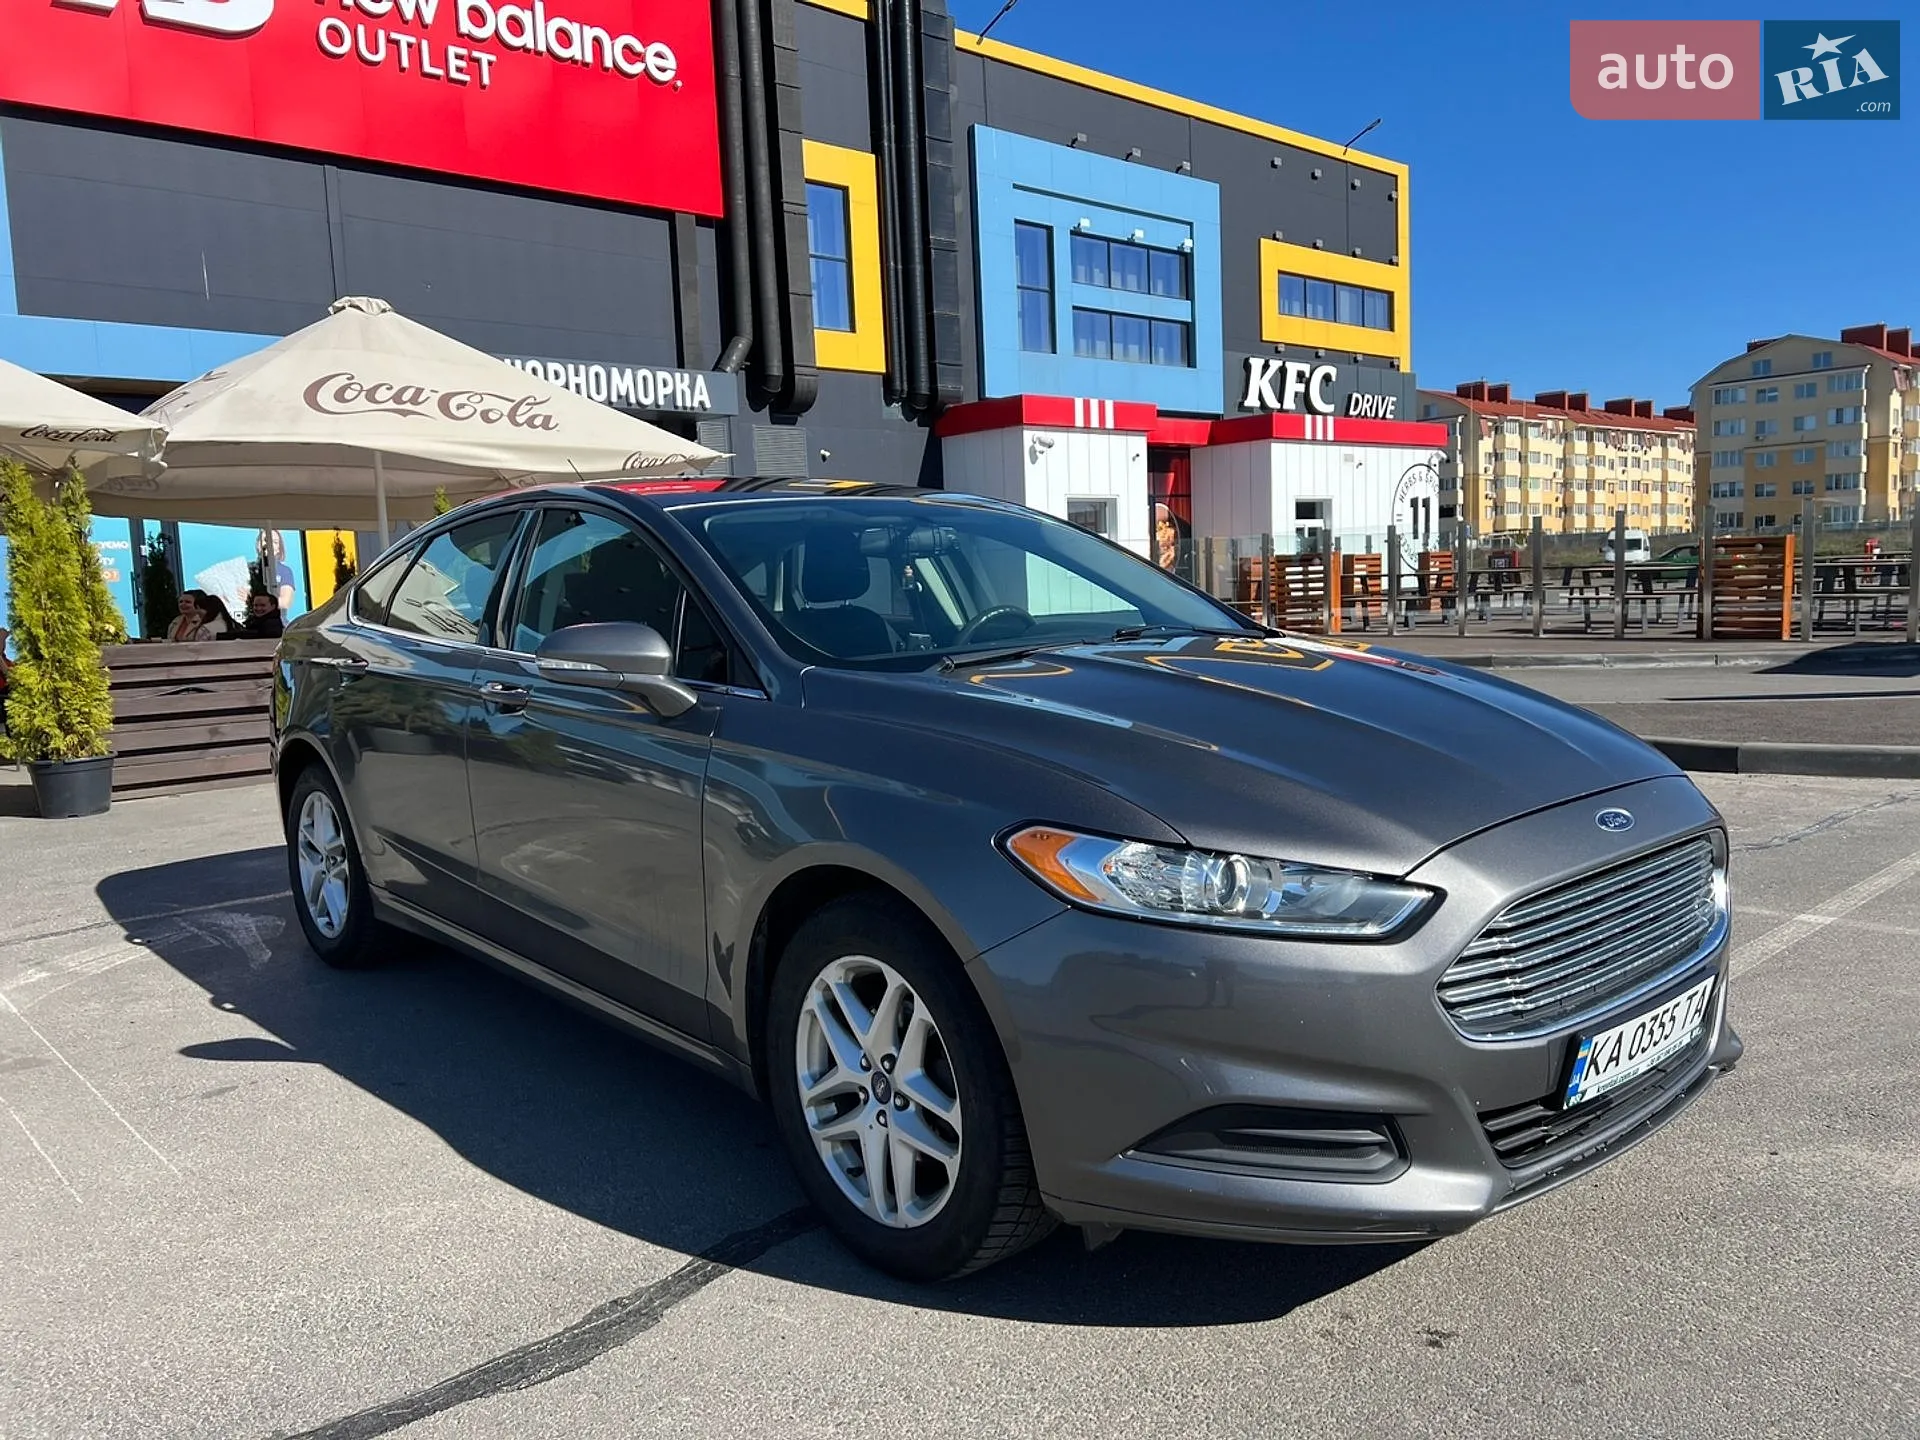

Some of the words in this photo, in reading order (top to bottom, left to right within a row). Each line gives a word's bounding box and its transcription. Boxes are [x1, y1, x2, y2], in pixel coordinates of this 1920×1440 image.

[317, 17, 497, 89] OUTLET
[303, 372, 559, 432] Coca-Cola
[504, 358, 712, 410] РНОМОРКА
[1243, 356, 1337, 414] KFC
[1348, 391, 1397, 419] DRIVE
[1410, 496, 1430, 540] 11
[1584, 1031, 1624, 1081] KA
[1628, 1001, 1680, 1060] 0355
[1682, 985, 1708, 1028] TA
